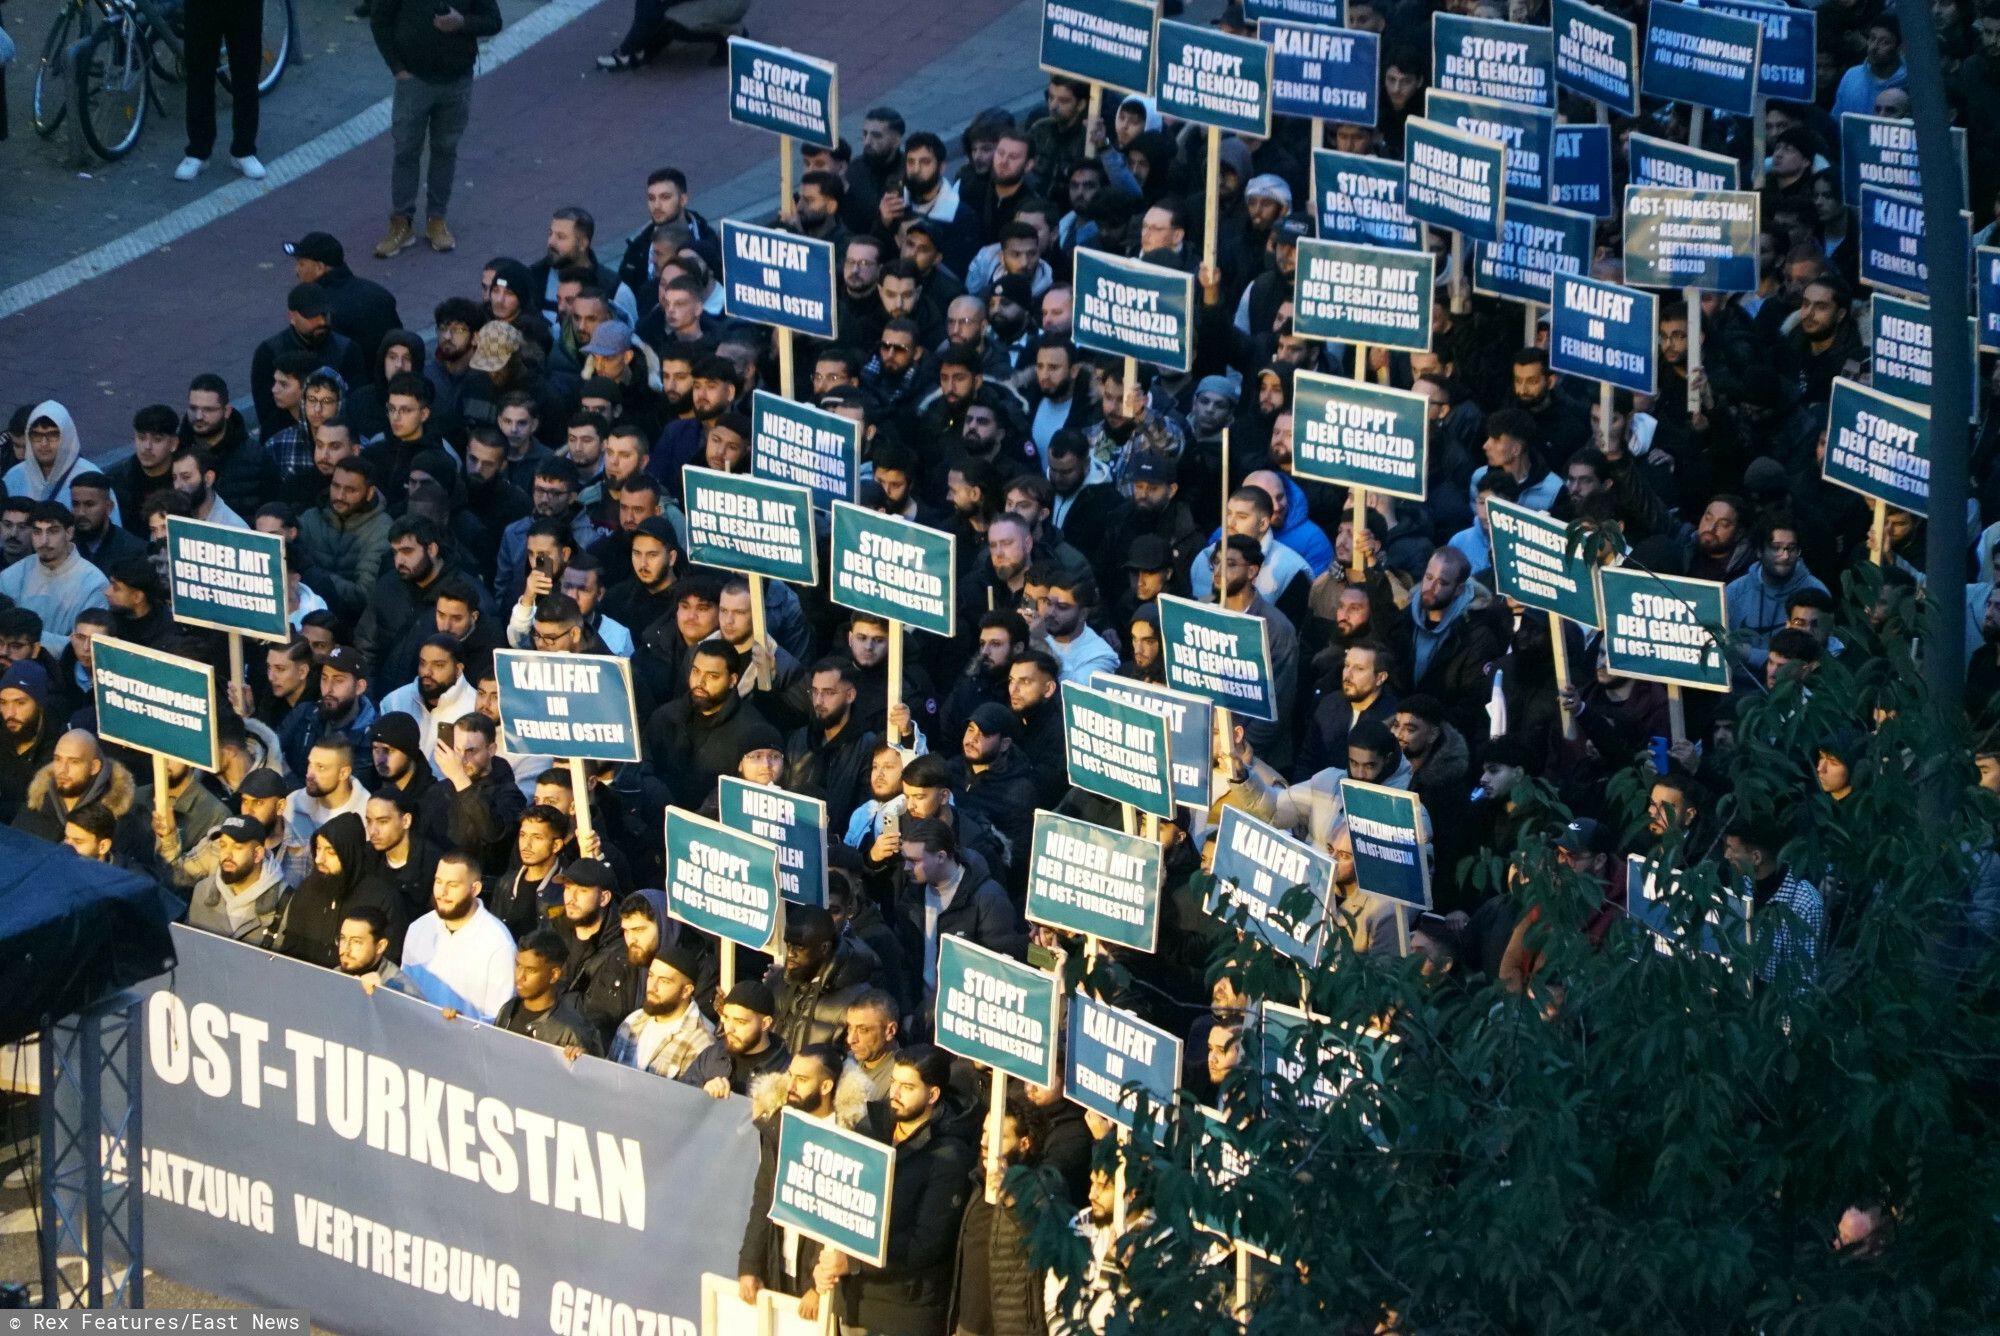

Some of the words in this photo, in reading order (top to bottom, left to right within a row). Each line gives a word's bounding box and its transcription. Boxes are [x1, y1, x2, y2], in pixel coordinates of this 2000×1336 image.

[1047, 4, 1149, 46] SCHUTZKAMPAGNE
[1570, 18, 1614, 55] STOPPT
[1183, 44, 1242, 77] STOPPT
[1274, 28, 1354, 62] KALIFAT
[1461, 36, 1528, 64] STOPPT
[1560, 34, 1580, 55] DEN
[1581, 45, 1627, 80] GENOZID
[1651, 26, 1753, 63] SCHUTZKAMPAGNE
[753, 58, 809, 94] STOPPT
[1168, 63, 1193, 86] DEN
[1197, 71, 1259, 101] GENOZID
[1303, 62, 1321, 80] IM
[1442, 75, 1454, 90] IN
[1456, 77, 1547, 104] OST-TURKESTAN
[1446, 55, 1475, 77] DEN
[1478, 60, 1545, 87] GENOZID
[1761, 63, 1805, 84] OSTEN
[736, 94, 746, 110] IN
[748, 99, 825, 134] OST-TURKESTAN
[741, 75, 764, 99] DEN
[768, 85, 821, 117] GENOZID
[1163, 84, 1173, 101] IN
[1175, 87, 1259, 119] OST-TURKESTAN
[1322, 87, 1367, 109] OSTEN
[1414, 141, 1457, 176] NIEDER
[1460, 157, 1490, 184] MIT
[1641, 156, 1693, 188] NIEDER
[1697, 171, 1725, 190] MIT
[1337, 171, 1398, 201] STOPPT
[1410, 163, 1428, 186] DER
[1428, 170, 1490, 203] BESATZUNG
[1409, 182, 1418, 199] IN
[1419, 186, 1490, 222] OST-TURKESTAN
[1630, 196, 1753, 222] OST-TURKESTAN:
[1324, 213, 1335, 229] IN
[1504, 220, 1565, 252] STOPPT
[1659, 223, 1721, 239] BESATZUNG
[736, 232, 809, 272] KALIFAT
[1658, 241, 1733, 259] VERTREIBUNG
[1900, 236, 1917, 255] IM
[763, 268, 780, 288] IM
[1310, 258, 1378, 288] NIEDER
[1382, 268, 1419, 292] MIT
[1481, 260, 1493, 276] IN
[1658, 259, 1705, 273] GENOZID
[1870, 250, 1916, 279] FERNEN
[735, 283, 781, 311] FERNEN
[783, 295, 823, 321] OSTEN
[1098, 277, 1159, 312] STOPPT
[1302, 280, 1330, 300] DER
[1334, 285, 1418, 312] BESATZUNG
[1565, 281, 1633, 324] KALIFAT
[1080, 314, 1091, 330] IN
[1092, 320, 1179, 352] OST-TURKESTAN
[1085, 294, 1109, 320] DEN
[1112, 304, 1178, 335] GENOZID
[1301, 300, 1315, 316] IN
[1318, 303, 1419, 329] OST-TURKESTAN
[1588, 319, 1604, 340] IM
[1561, 335, 1603, 363] FERNEN
[1606, 348, 1644, 374] OSTEN
[763, 412, 812, 447] NIEDER
[816, 429, 845, 457] MIT
[1325, 400, 1397, 434] STOPPT
[1856, 411, 1919, 452] STOPPT
[757, 434, 777, 456] DER
[781, 441, 845, 478] BESATZUNG
[1306, 420, 1339, 445] DEN
[1342, 428, 1414, 459] GENOZID
[1832, 448, 1844, 465] IN
[1839, 427, 1866, 455] DEN
[757, 454, 767, 470] IN
[769, 458, 846, 496] OST-TURKESTAN
[1301, 442, 1314, 459] IN
[1316, 446, 1416, 478] OST-TURKESTAN
[697, 488, 758, 520] NIEDER
[761, 500, 796, 525] MIT
[691, 511, 717, 531] DER
[720, 516, 800, 545] BESATZUNG
[179, 537, 236, 569] NIEDER
[239, 549, 270, 574] MIT
[692, 530, 707, 544] IN
[709, 533, 802, 564] OST-TURKESTAN
[859, 530, 925, 570] STOPPT
[175, 561, 199, 578] DER
[202, 567, 273, 596] BESATZUNG
[844, 550, 872, 574] DEN
[875, 561, 941, 597] GENOZID
[177, 581, 189, 598] IN
[190, 585, 276, 615] OST-TURKESTAN
[840, 571, 852, 588] IN
[854, 576, 944, 616] OST-TURKESTAN
[1632, 592, 1696, 623] STOPPT
[1184, 622, 1237, 657] STOPPT
[1617, 614, 1646, 639] DEN
[1173, 643, 1198, 667] DEN
[1199, 652, 1259, 682] GENOZID
[1614, 638, 1627, 654] IN
[97, 668, 207, 715] SCHUTZKAMPAGNE
[511, 662, 600, 693] KALIFAT
[1172, 665, 1182, 682] IN
[1183, 670, 1262, 701] OST-TURKESTAN
[547, 697, 569, 716] IM
[513, 719, 570, 741] FERNEN
[572, 723, 624, 743] OSTEN
[1072, 705, 1123, 741] NIEDER
[1125, 721, 1155, 754] MIT
[1070, 727, 1091, 753] DER
[1092, 738, 1158, 775] BESATZUNG
[1072, 749, 1082, 767] IN
[1083, 755, 1161, 795] OST-TURKESTAN
[743, 789, 795, 826] NIEDER
[752, 820, 768, 837] MIT
[770, 826, 786, 841] DER
[689, 840, 749, 882] STOPPT
[1046, 831, 1108, 873] NIEDER
[1110, 851, 1146, 882] MIT
[1231, 821, 1310, 884] KALIFAT
[677, 859, 702, 888] DEN
[703, 871, 768, 910] GENOZID
[1037, 855, 1062, 882] DER
[1065, 866, 1145, 905] BESATZUNG
[1253, 870, 1272, 897] IM
[672, 882, 683, 901] IN
[684, 887, 768, 932] OST-TURKESTAN
[1036, 876, 1048, 898] IN
[1049, 883, 1144, 926] OST-TURKESTAN
[964, 968, 1027, 1014] STOPPT
[947, 987, 975, 1019] DEN
[977, 1001, 1042, 1044] GENOZID
[943, 1012, 954, 1032] IN
[955, 1017, 1043, 1065] OST-TURKESTAN
[1084, 1004, 1156, 1066] KALIFAT
[1077, 1063, 1121, 1103] FERNEN
[1106, 1052, 1123, 1079] IM
[148, 990, 646, 1232] OST-TURKESTAN
[803, 1141, 863, 1187] STOPPT
[787, 1160, 814, 1193] DEN
[815, 1172, 876, 1217] GENOZID
[782, 1184, 793, 1204] IN
[794, 1191, 876, 1239] OST-TURKESTAN
[295, 1194, 519, 1318] VERTREIBUNG
